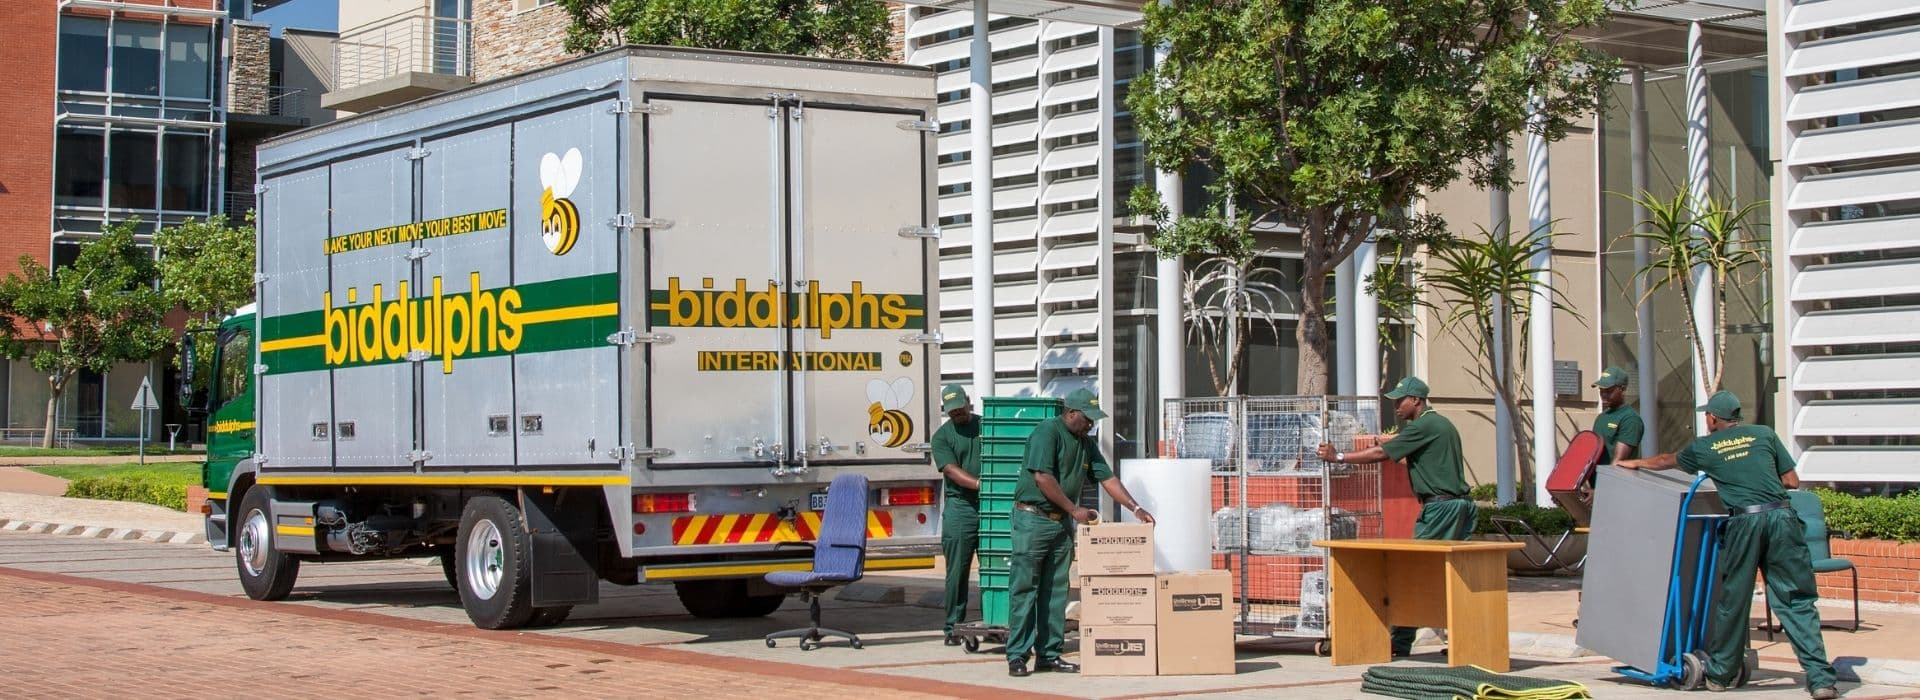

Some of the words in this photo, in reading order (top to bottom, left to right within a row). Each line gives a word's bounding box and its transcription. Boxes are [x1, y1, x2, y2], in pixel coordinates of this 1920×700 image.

[349, 231, 372, 250] YOUR
[374, 227, 397, 246] NEXT
[398, 222, 424, 242] MOVE
[425, 218, 450, 238] YOUR
[452, 214, 477, 234] BEST
[478, 209, 506, 231] MOVE
[324, 271, 523, 374] biddulphs
[668, 277, 908, 340] biddulphs
[699, 351, 882, 370] INTERNATIONAL
